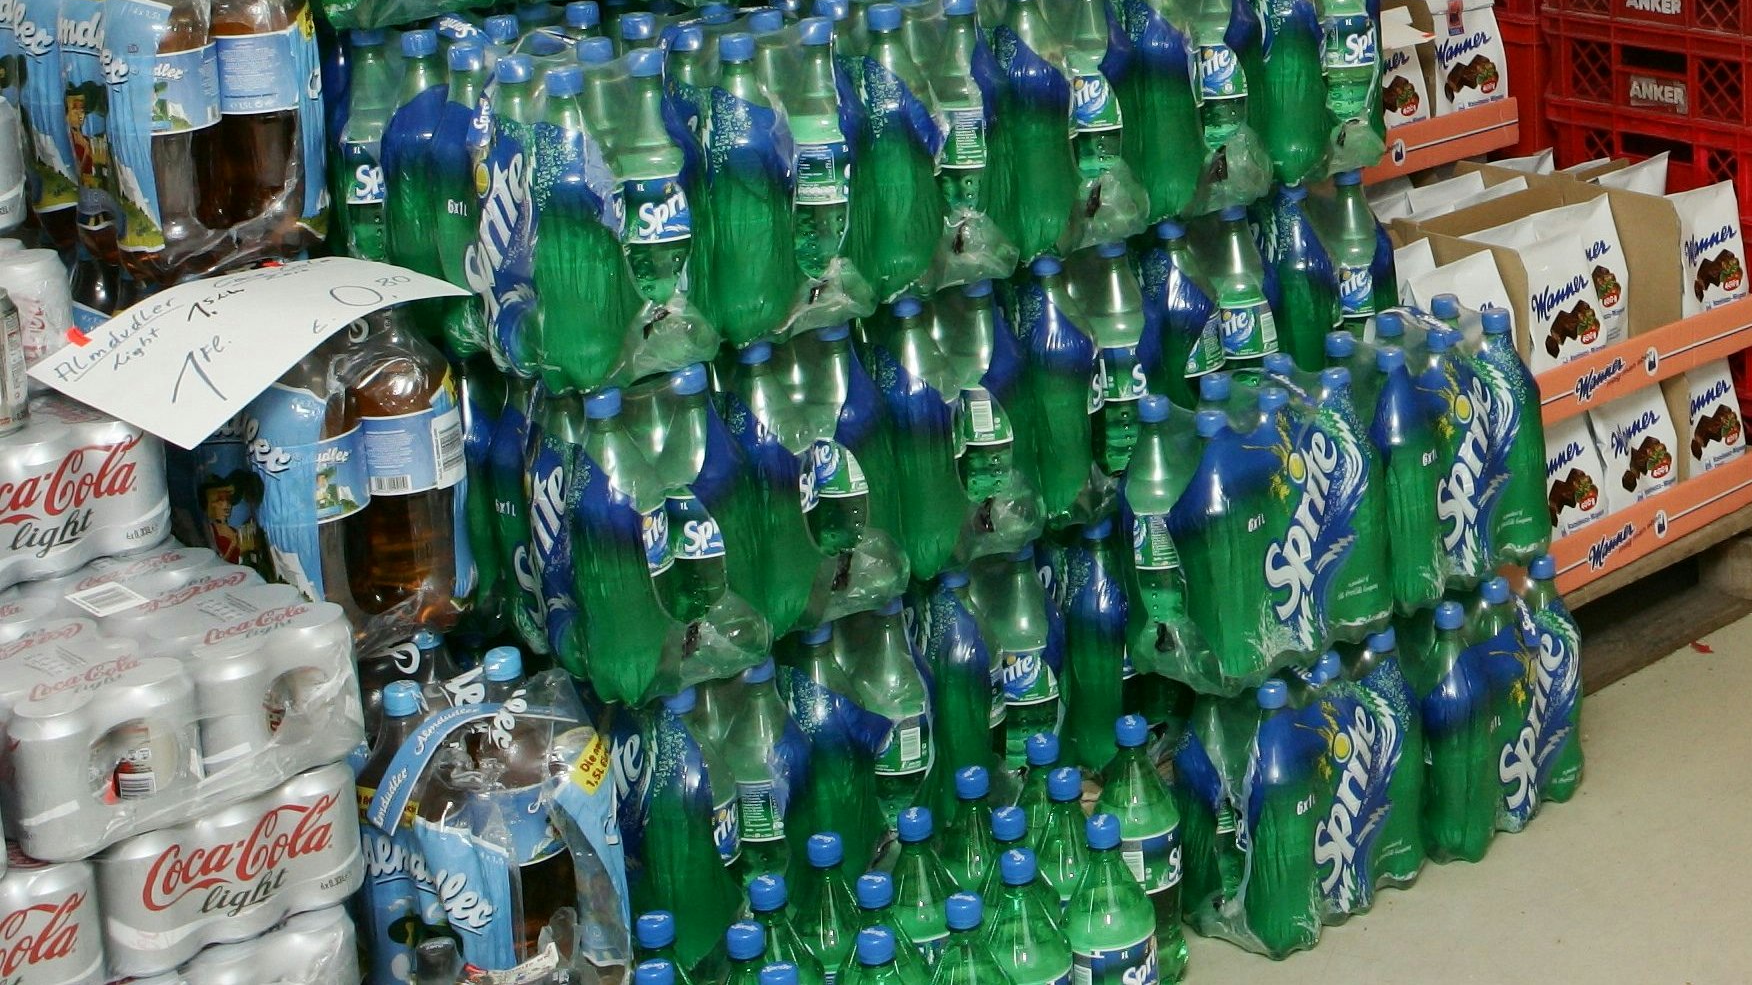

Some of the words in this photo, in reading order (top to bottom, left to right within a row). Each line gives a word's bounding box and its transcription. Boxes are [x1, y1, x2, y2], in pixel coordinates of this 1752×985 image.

[1435, 30, 1492, 70] Manner
[1629, 78, 1686, 106] ANKER
[1685, 223, 1738, 268] Manner
[1531, 272, 1589, 323] Manner
[1575, 356, 1626, 402] Manner
[1610, 408, 1661, 460] Manner
[0, 430, 144, 516] ca-Cola
[1437, 376, 1493, 551] Sprite
[6, 508, 95, 559] light
[1246, 513, 1266, 533] 6x1L
[1265, 430, 1338, 621] Sprite
[1588, 522, 1636, 570] Manner
[29, 655, 141, 702] Coca-Cola
[414, 706, 481, 756] Almdudler
[1498, 631, 1565, 812] Sprite
[1313, 702, 1377, 895] Sprite
[142, 789, 341, 912] Coca-Cola
[200, 868, 288, 919] light
